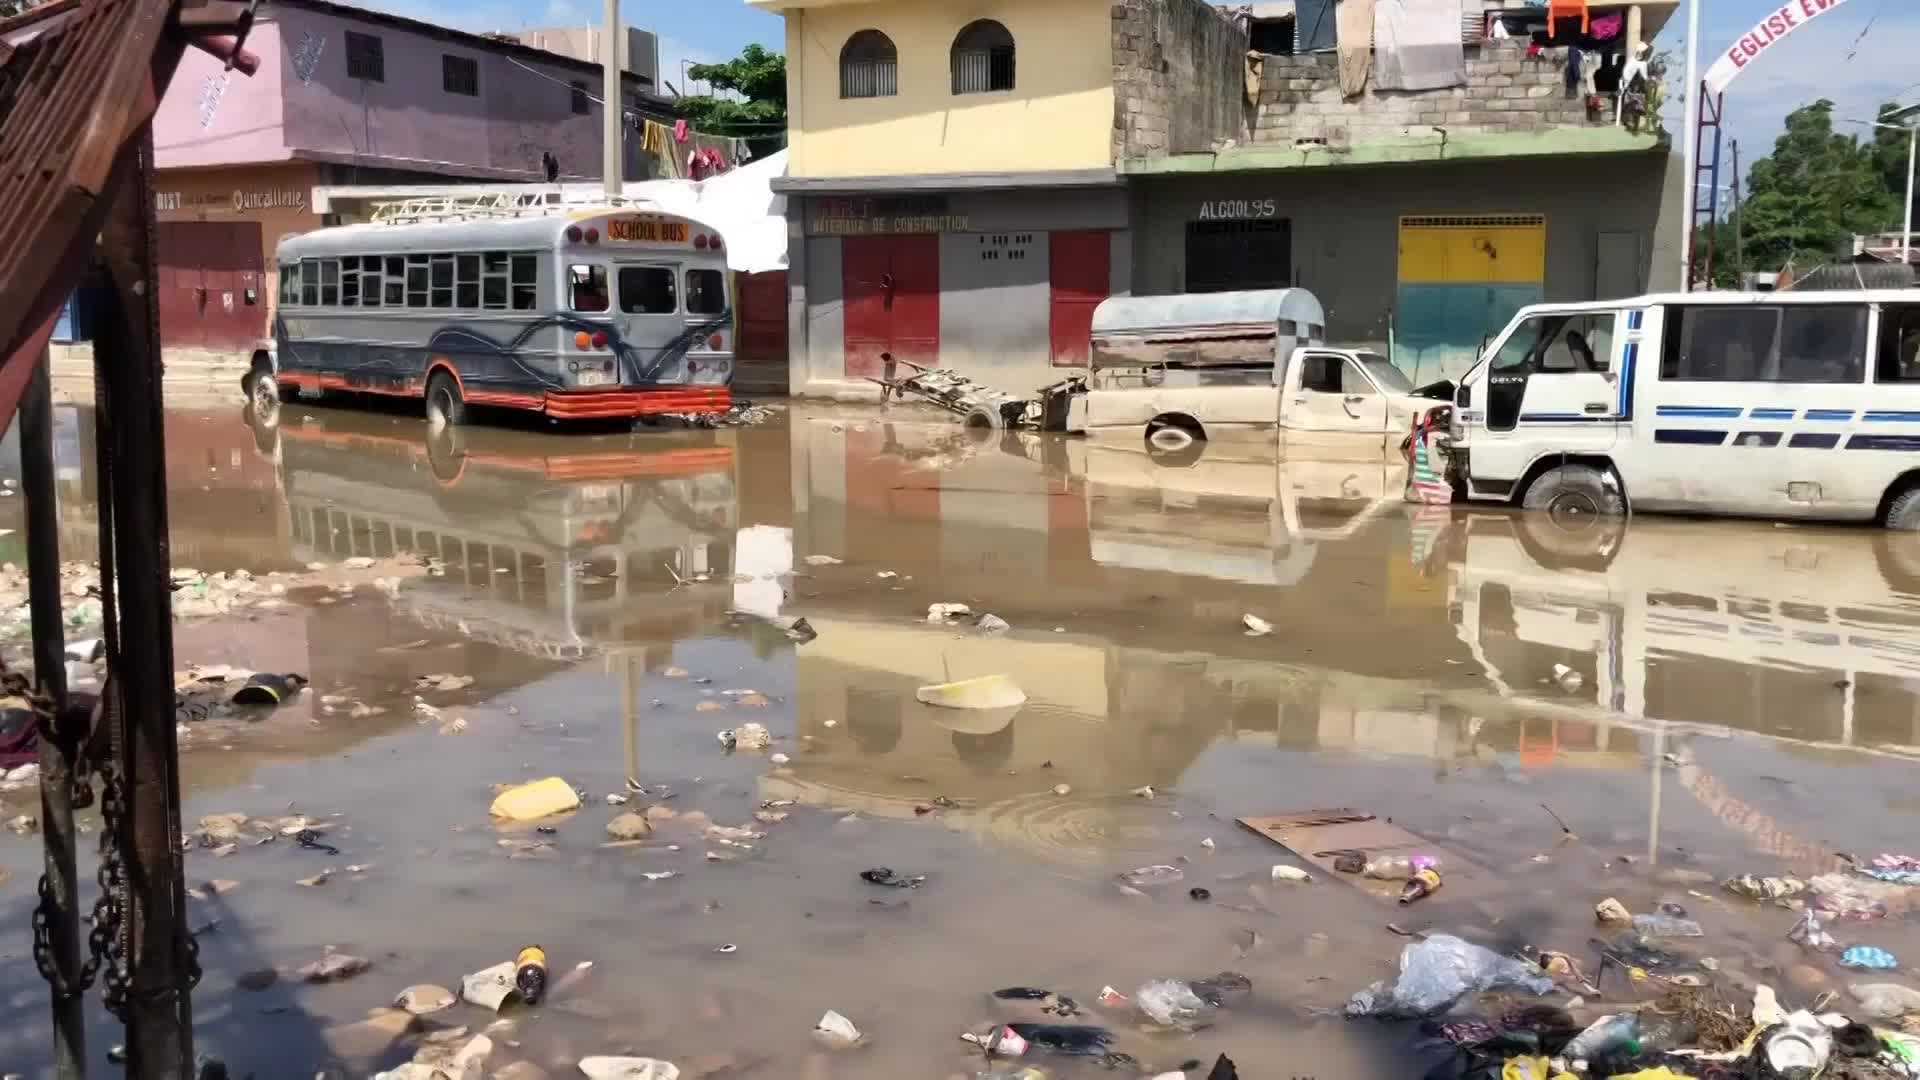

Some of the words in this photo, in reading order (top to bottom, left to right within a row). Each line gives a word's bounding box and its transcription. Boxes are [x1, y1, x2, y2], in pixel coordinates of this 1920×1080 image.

[1728, 7, 1798, 67] EGLISE
[1800, 0, 1836, 17] EV
[613, 220, 656, 241] SCHOOL
[661, 222, 685, 242] BUS
[872, 216, 889, 232] DE
[894, 215, 969, 233] CONSTRUCTION
